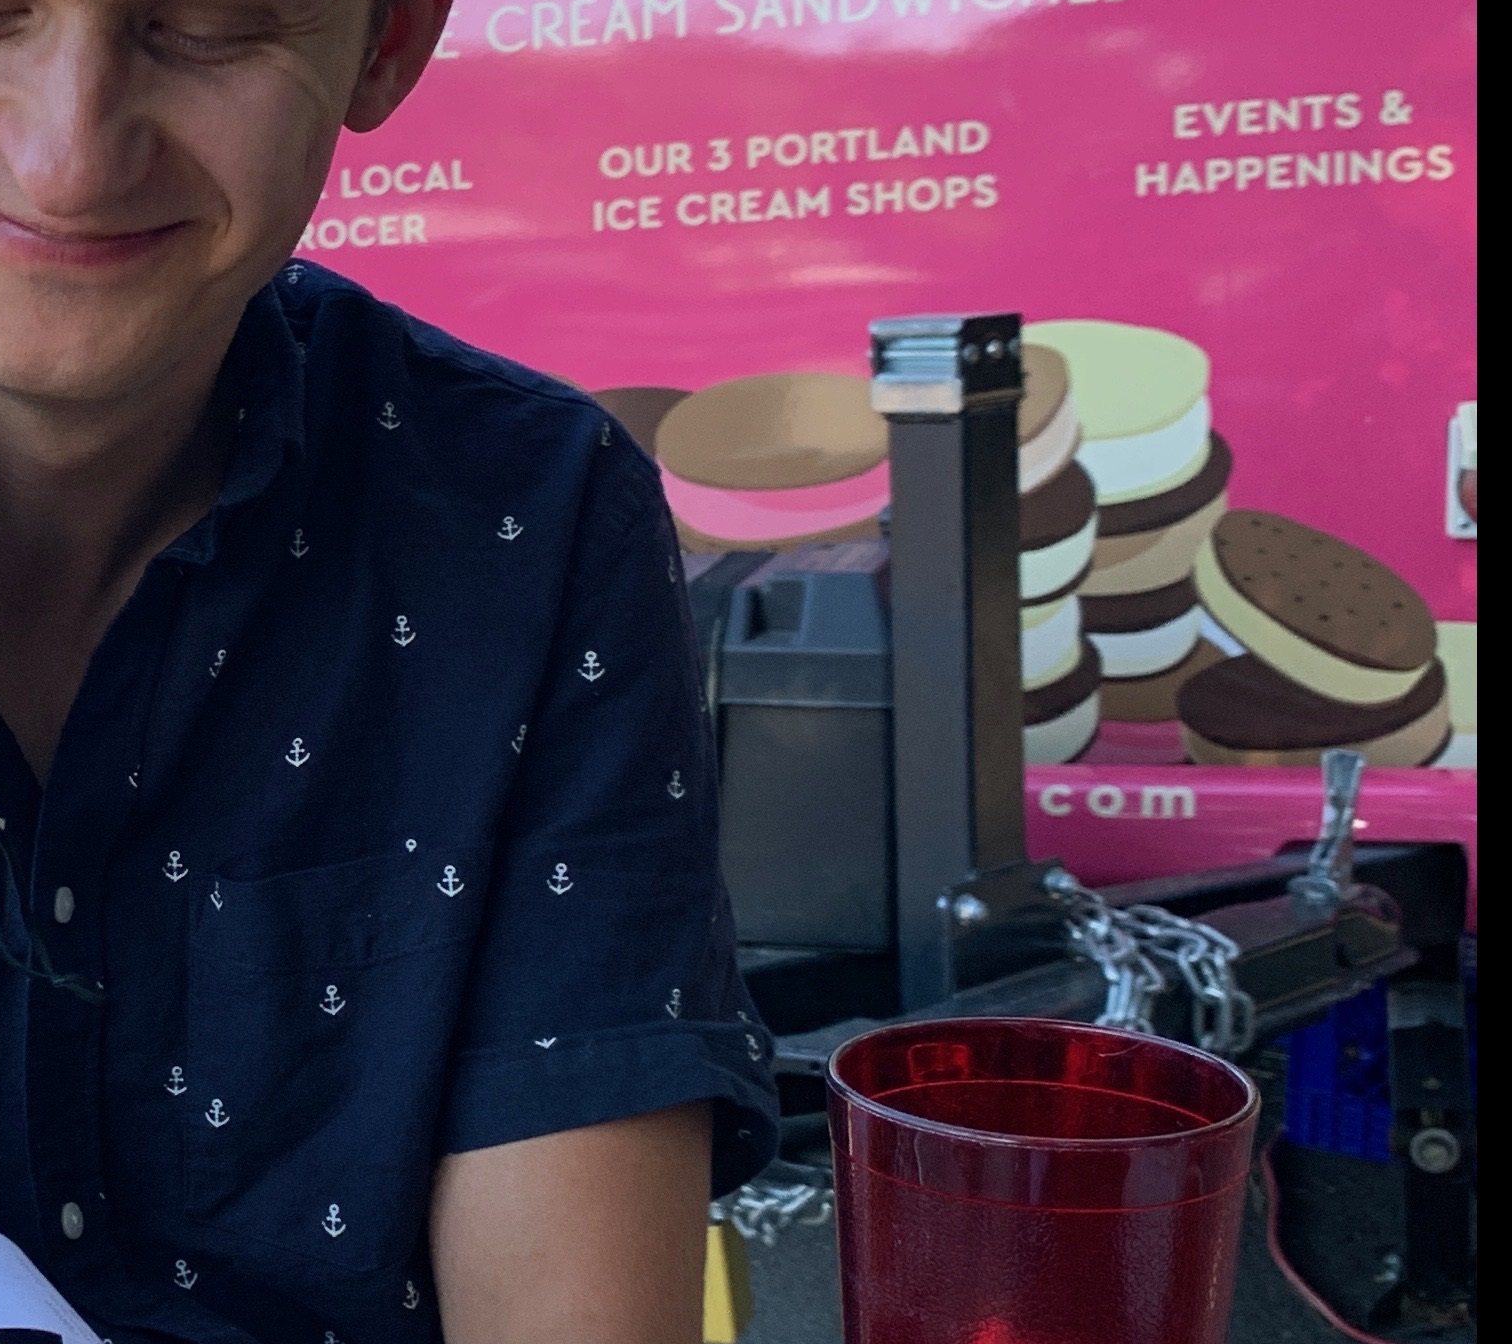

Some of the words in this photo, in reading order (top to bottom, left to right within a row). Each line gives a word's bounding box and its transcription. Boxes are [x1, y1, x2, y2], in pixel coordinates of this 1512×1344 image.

[1172, 92, 1363, 139] EVENTS
[1379, 89, 1413, 127] &
[598, 141, 694, 179] OUR
[707, 138, 732, 172] 3
[746, 120, 990, 170] PORTLAND
[1134, 144, 1455, 198] HAPPENINGS
[341, 159, 474, 199] LOCAL
[592, 196, 663, 232] ICE
[676, 185, 831, 227] CREAM
[846, 173, 999, 216] SHOPS
[294, 212, 429, 252] ROCER
[1040, 783, 1196, 820] com
